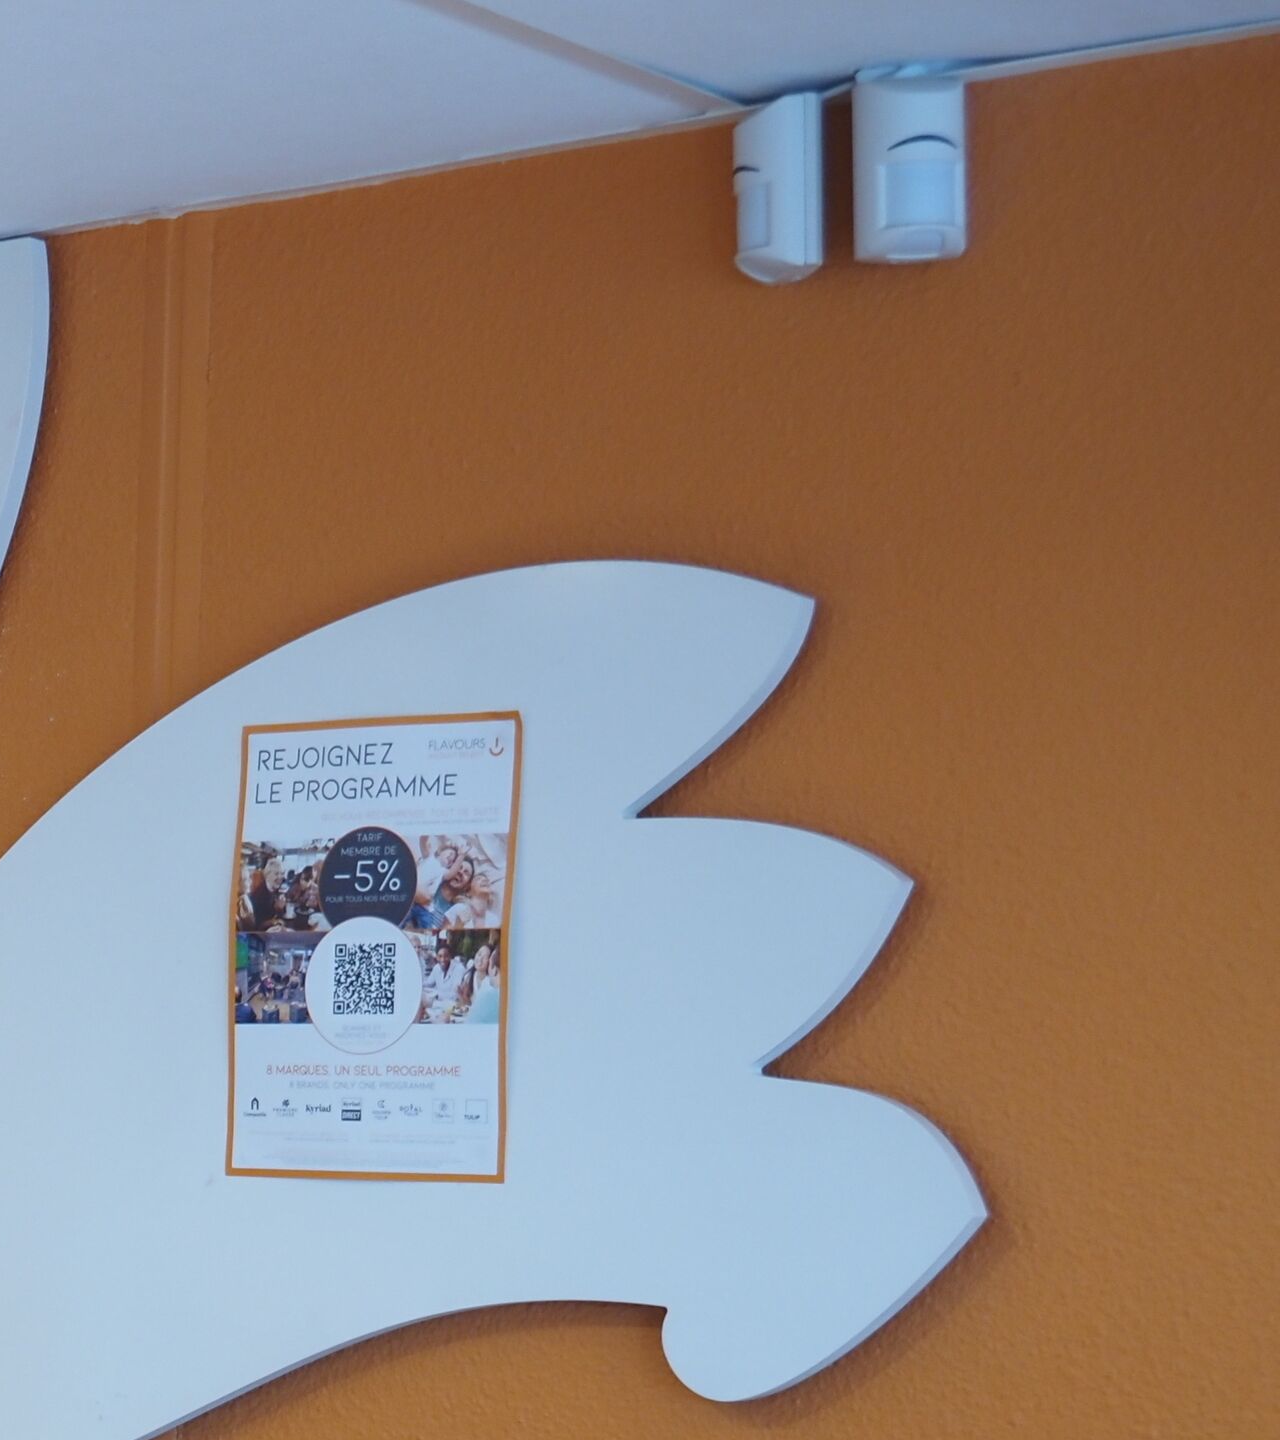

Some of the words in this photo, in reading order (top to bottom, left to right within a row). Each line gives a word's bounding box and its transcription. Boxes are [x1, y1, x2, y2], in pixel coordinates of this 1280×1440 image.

[428, 737, 486, 751] FLAVOURS
[256, 742, 394, 772] REJOIGNEZ
[254, 781, 282, 805] LE
[289, 773, 459, 804] PROGRAMME
[356, 832, 384, 842] TARIF
[340, 846, 382, 857] MEMBRE
[383, 845, 398, 856] DE
[333, 859, 401, 893] -5%
[266, 1064, 274, 1075] 8
[334, 1065, 351, 1075] UN
[354, 1065, 382, 1076] SEUL
[386, 1065, 462, 1077] PROGRAMME
[305, 1104, 332, 1114] Kyriad
